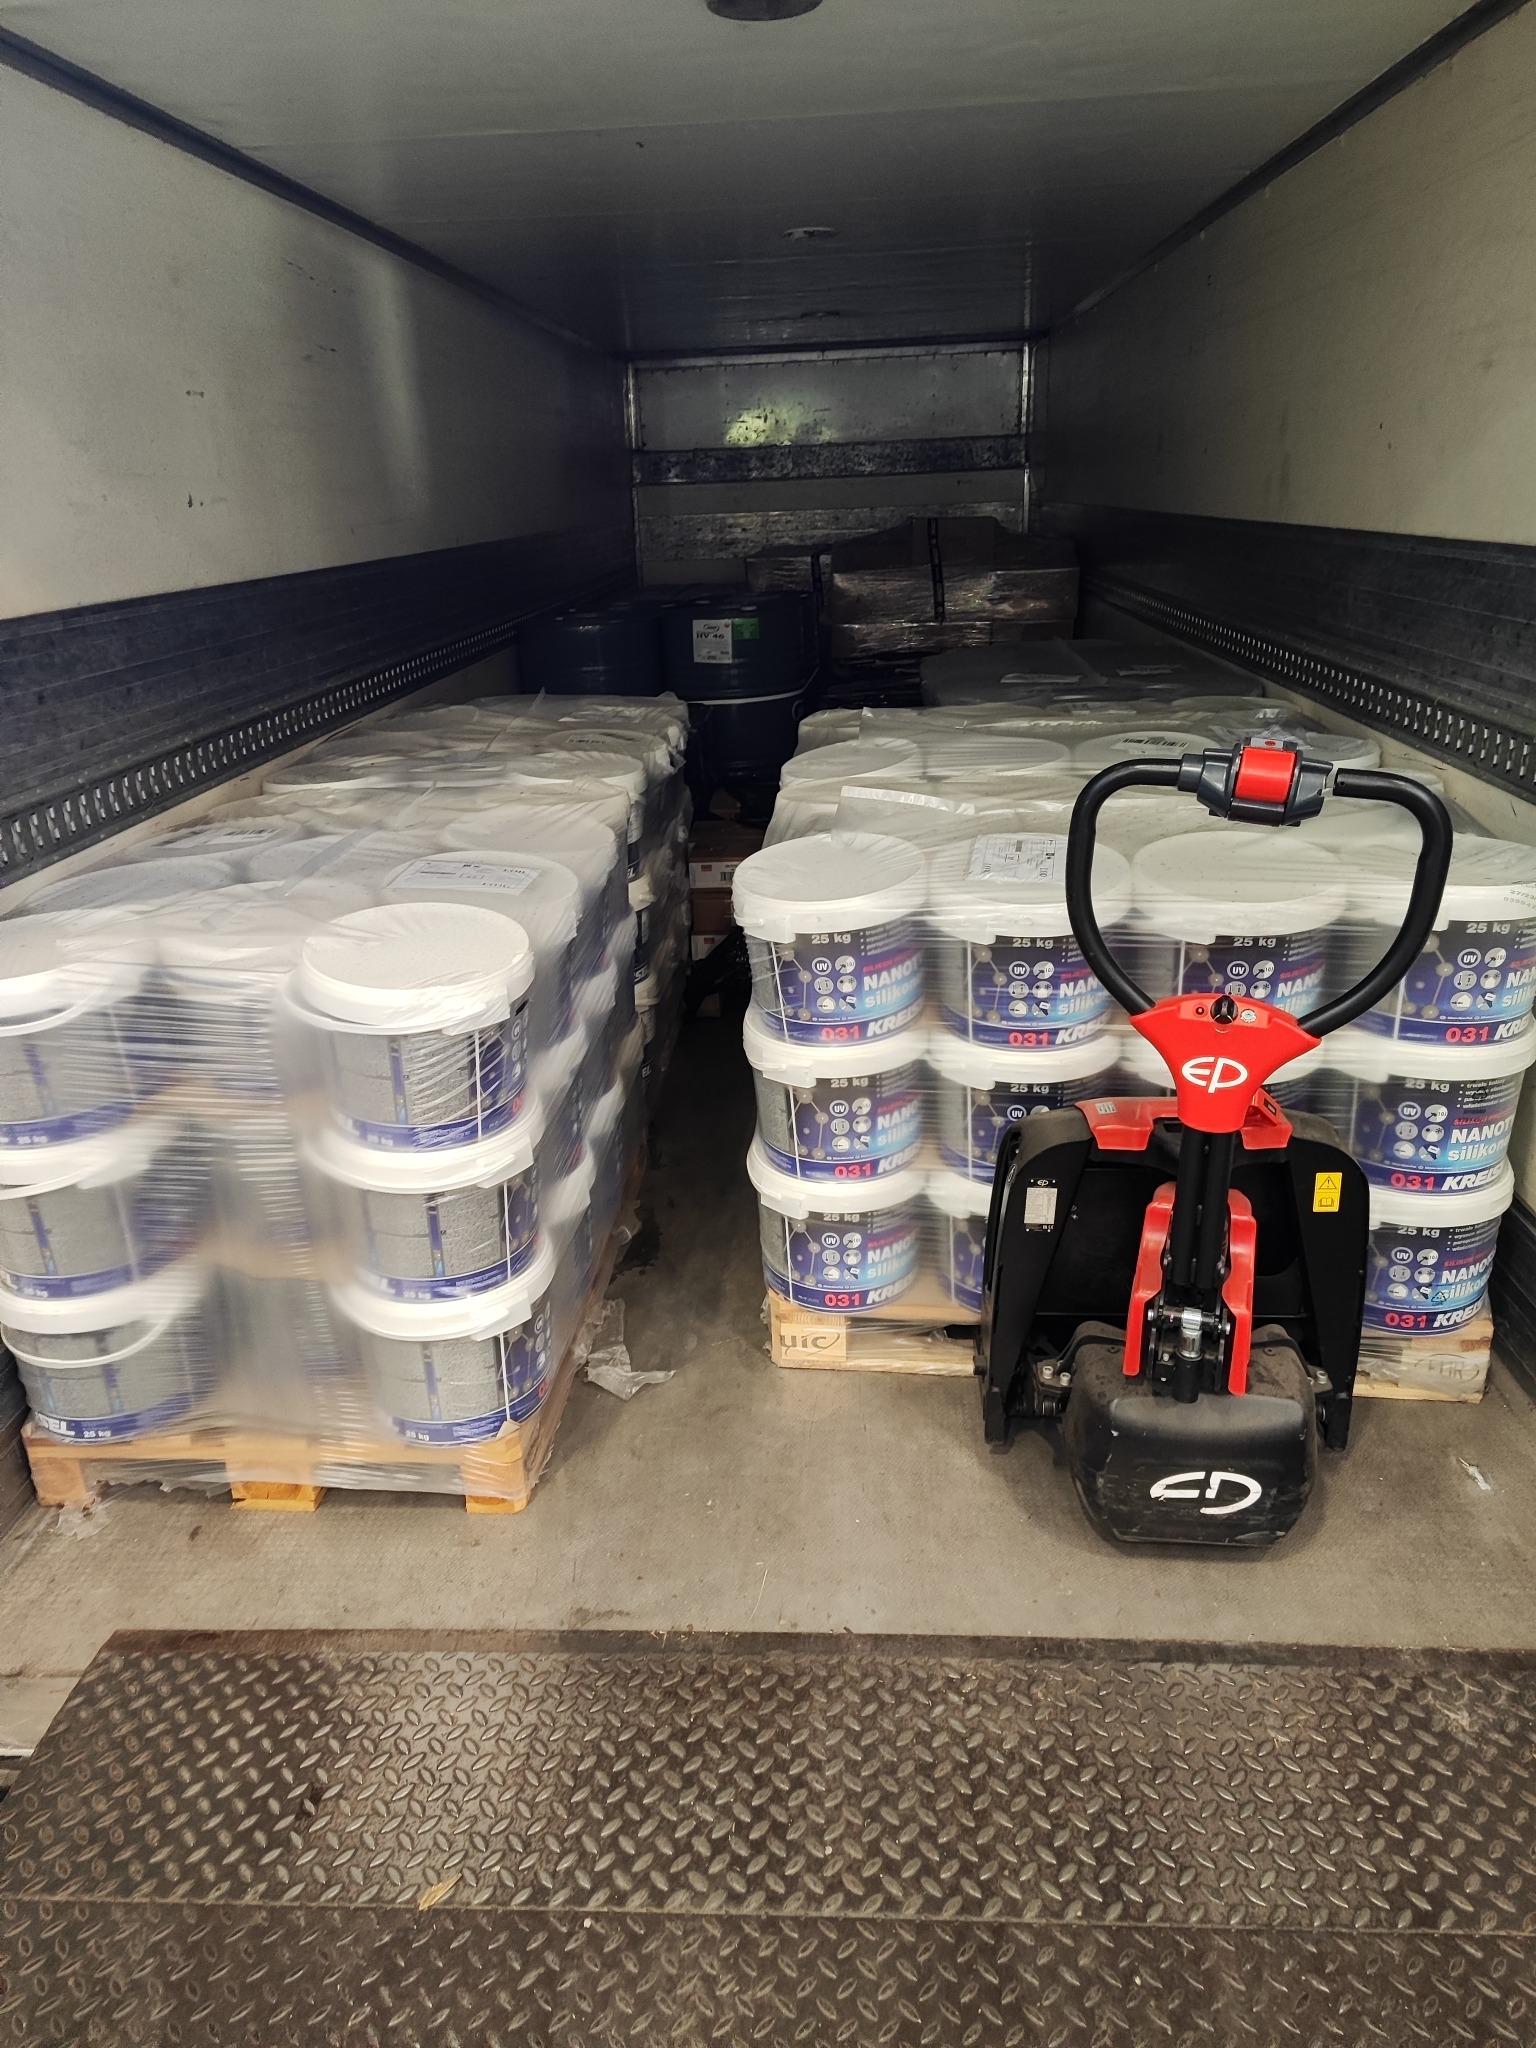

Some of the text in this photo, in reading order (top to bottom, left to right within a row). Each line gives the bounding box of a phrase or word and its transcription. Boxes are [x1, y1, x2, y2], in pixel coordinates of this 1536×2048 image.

[1466, 922, 1511, 934] 25 kg
[811, 933, 851, 944] 25 kg
[1012, 938, 1054, 949] 25 kg
[1233, 937, 1277, 948] 25 kg
[1463, 954, 1477, 963] UV
[816, 963, 828, 971] UV
[1013, 966, 1026, 974] UV
[1232, 966, 1245, 975] UV
[821, 1025, 860, 1041] 031
[1446, 1027, 1490, 1043] 031
[1008, 1032, 1051, 1047] 031
[1181, 1056, 1248, 1094] EP
[830, 1078, 869, 1088] 25 kg
[1010, 1083, 1050, 1094] 25 kg
[1405, 1078, 1450, 1093] 25 kg
[834, 1105, 846, 1113] UV
[1011, 1110, 1023, 1118] UV
[1402, 1105, 1418, 1116] UV
[834, 1161, 872, 1179] 031
[1390, 1173, 1435, 1191] 031
[823, 1213, 861, 1223] 25 kg
[1397, 1227, 1440, 1238] 25 kg
[826, 1236, 837, 1245] UV
[1396, 1252, 1409, 1260] UV
[824, 1293, 861, 1307] 031
[1385, 1312, 1427, 1328] 031
